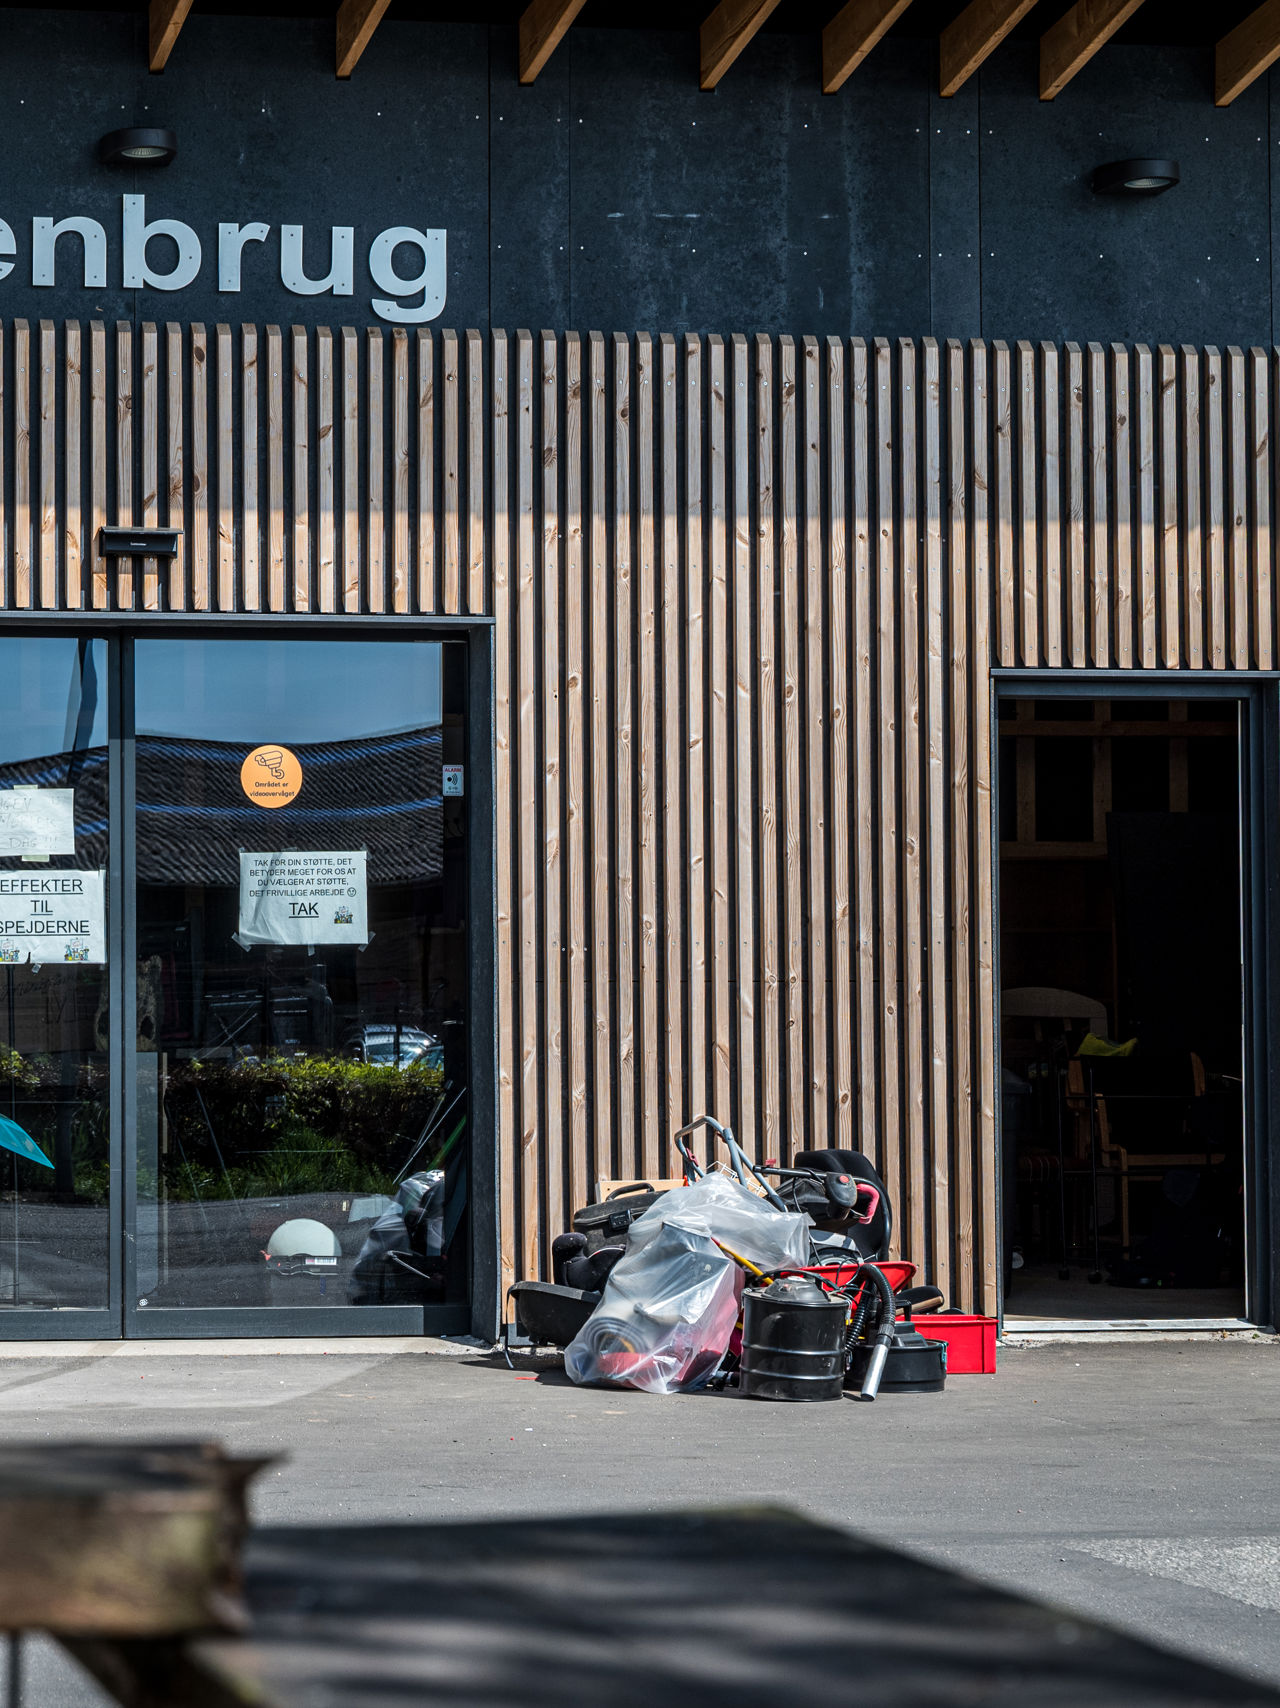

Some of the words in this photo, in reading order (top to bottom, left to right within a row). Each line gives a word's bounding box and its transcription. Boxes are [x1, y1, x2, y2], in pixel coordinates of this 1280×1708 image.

[250, 790, 295, 798] videoovervåget
[254, 859, 268, 867] TAK
[270, 859, 286, 867] FOR
[303, 858, 336, 867] STØTTE,
[337, 858, 352, 866] DET
[250, 868, 286, 877] BETYDER
[287, 867, 314, 876] MEGET
[316, 867, 333, 876] FOR
[334, 867, 346, 876] OS
[347, 867, 357, 875] AT
[0, 879, 84, 894] EFFEKTER
[257, 879, 269, 887] DU
[271, 878, 305, 886] VÆLGER
[305, 878, 315, 886] AT
[317, 878, 349, 886] STØTTE,
[249, 889, 265, 897] DET
[266, 889, 308, 897] FRIVILLIGE
[309, 888, 345, 896] ARBEJDE
[30, 900, 54, 915] TIL
[288, 902, 319, 917] TAK
